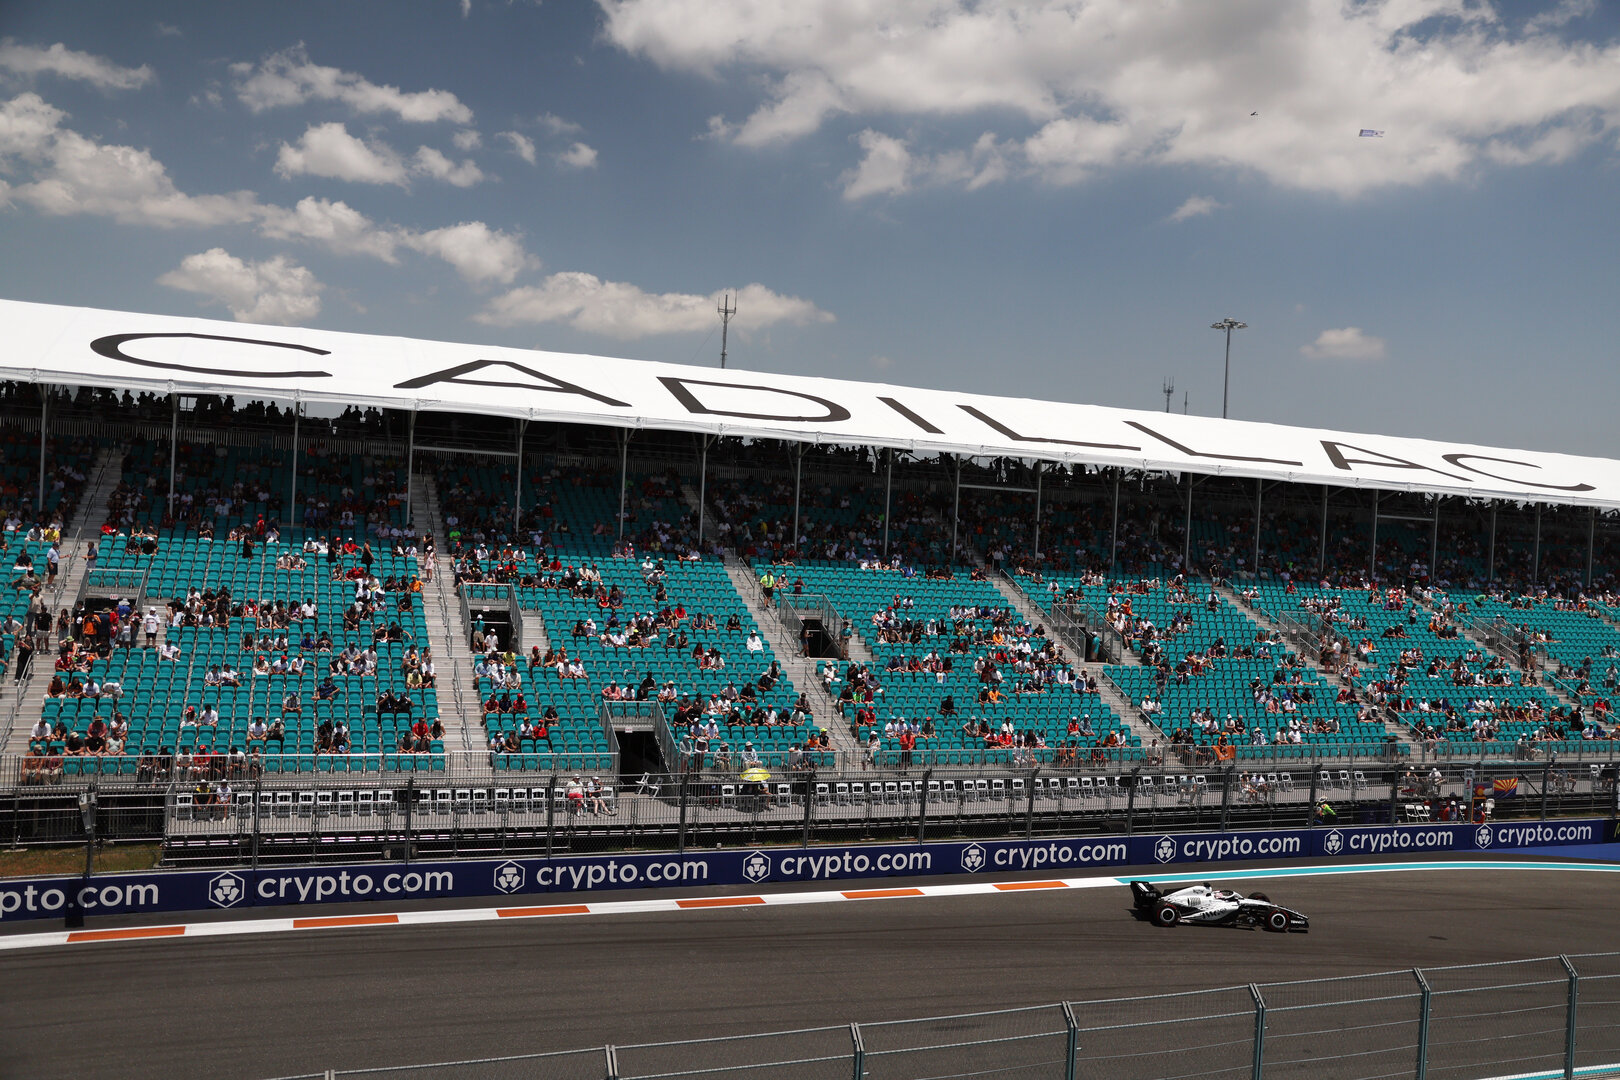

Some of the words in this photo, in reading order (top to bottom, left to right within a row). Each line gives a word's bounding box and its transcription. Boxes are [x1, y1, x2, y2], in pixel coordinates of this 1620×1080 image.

[90, 333, 1596, 491] CADILLAC
[1183, 836, 1301, 860] crypto.com
[1349, 829, 1453, 852] crypto.com
[1498, 824, 1592, 846] crypto.com
[781, 852, 932, 879] crypto.com
[994, 843, 1127, 869] crypto.com
[258, 871, 454, 902] crypto.com
[537, 861, 708, 890] crypto.com
